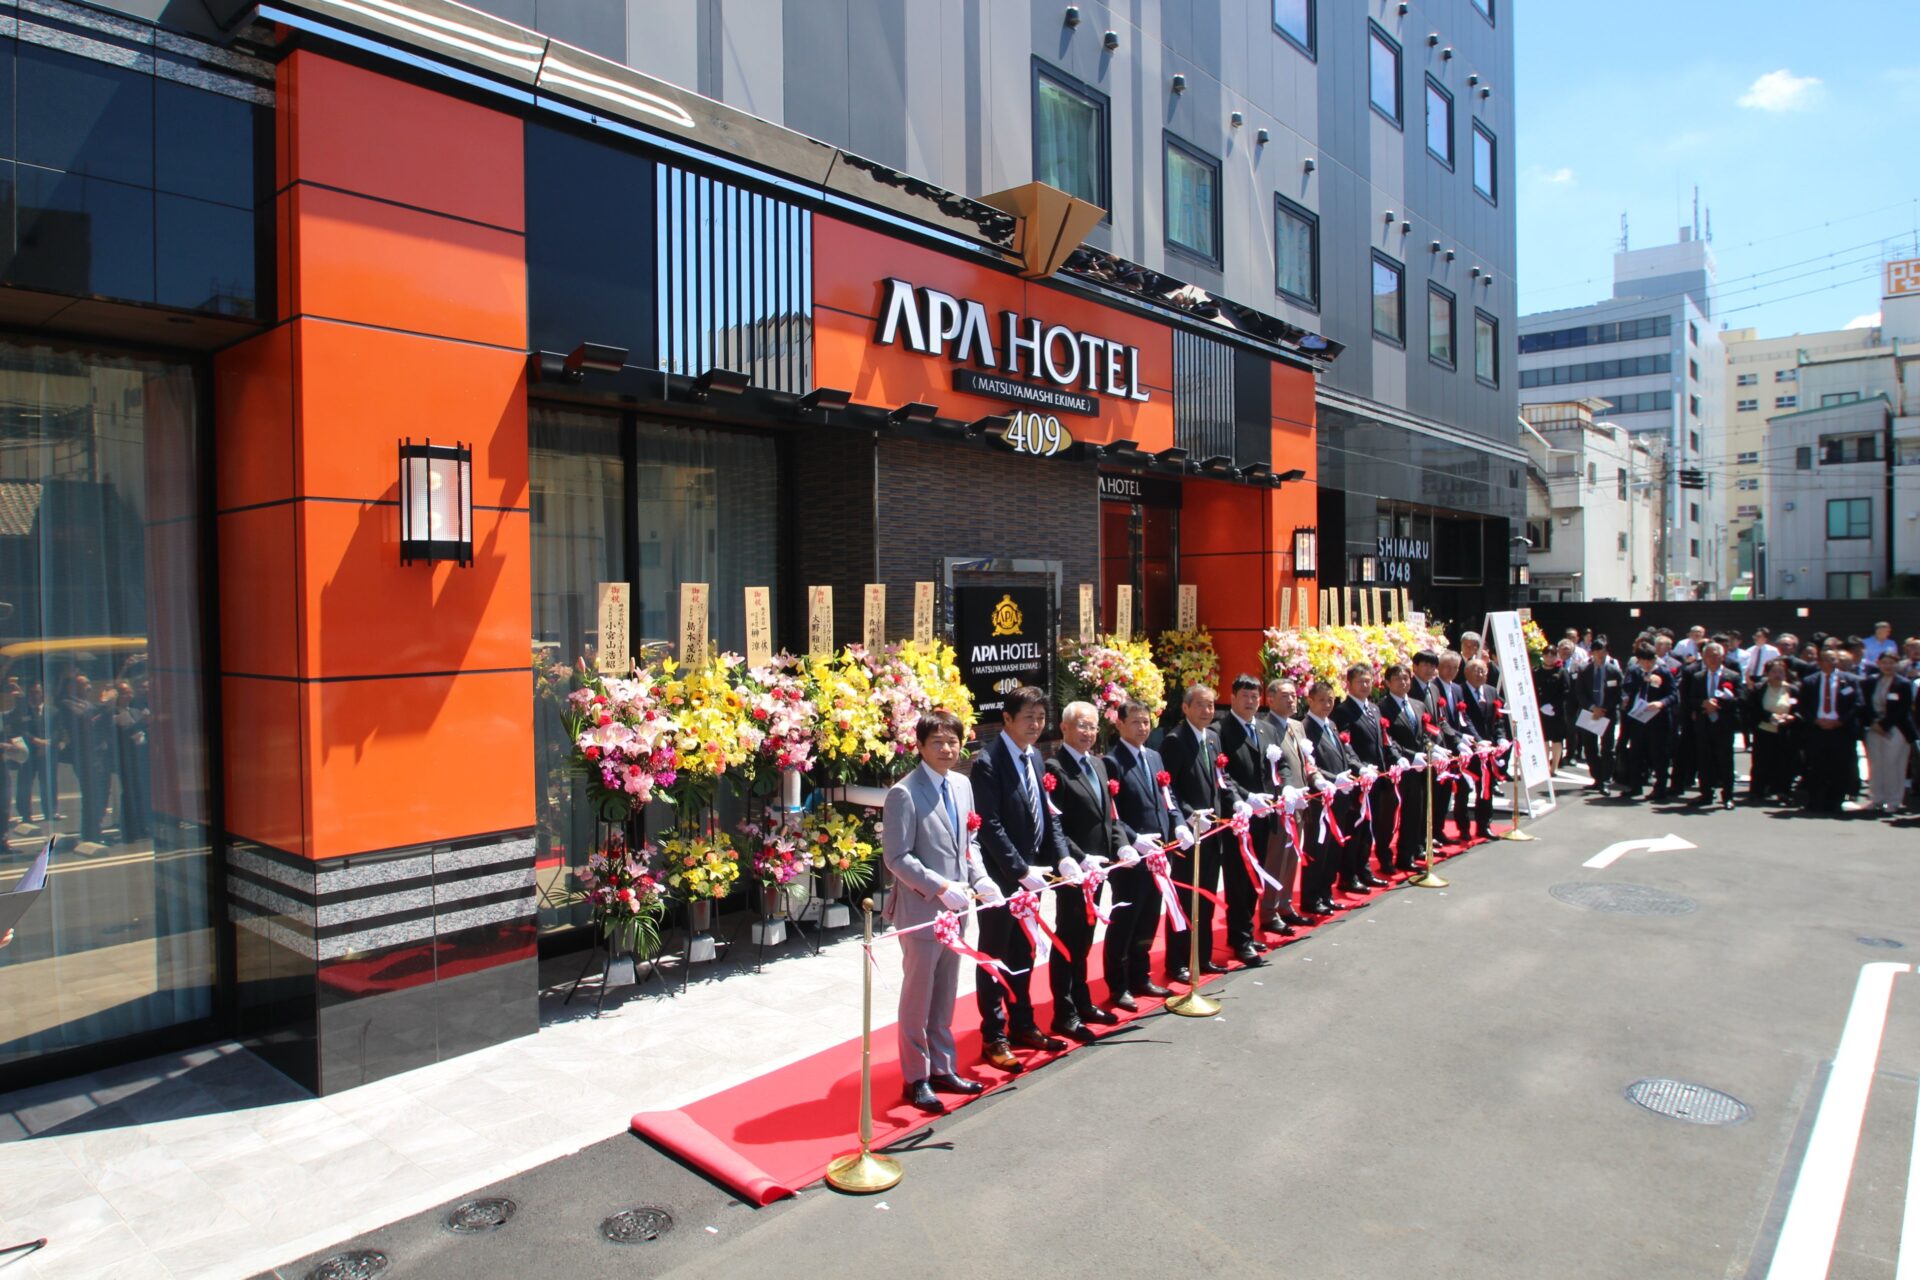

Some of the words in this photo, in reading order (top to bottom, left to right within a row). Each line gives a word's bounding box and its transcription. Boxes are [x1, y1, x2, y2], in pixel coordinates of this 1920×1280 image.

[879, 278, 996, 367] APA
[1006, 311, 1150, 402] HOTEL
[1006, 410, 1061, 457] 409
[1107, 477, 1142, 496] HOTEL
[1378, 536, 1429, 560] SHIMARU
[1382, 562, 1411, 582] 1948
[971, 644, 999, 662] APA
[1000, 642, 1041, 661] HOTEL
